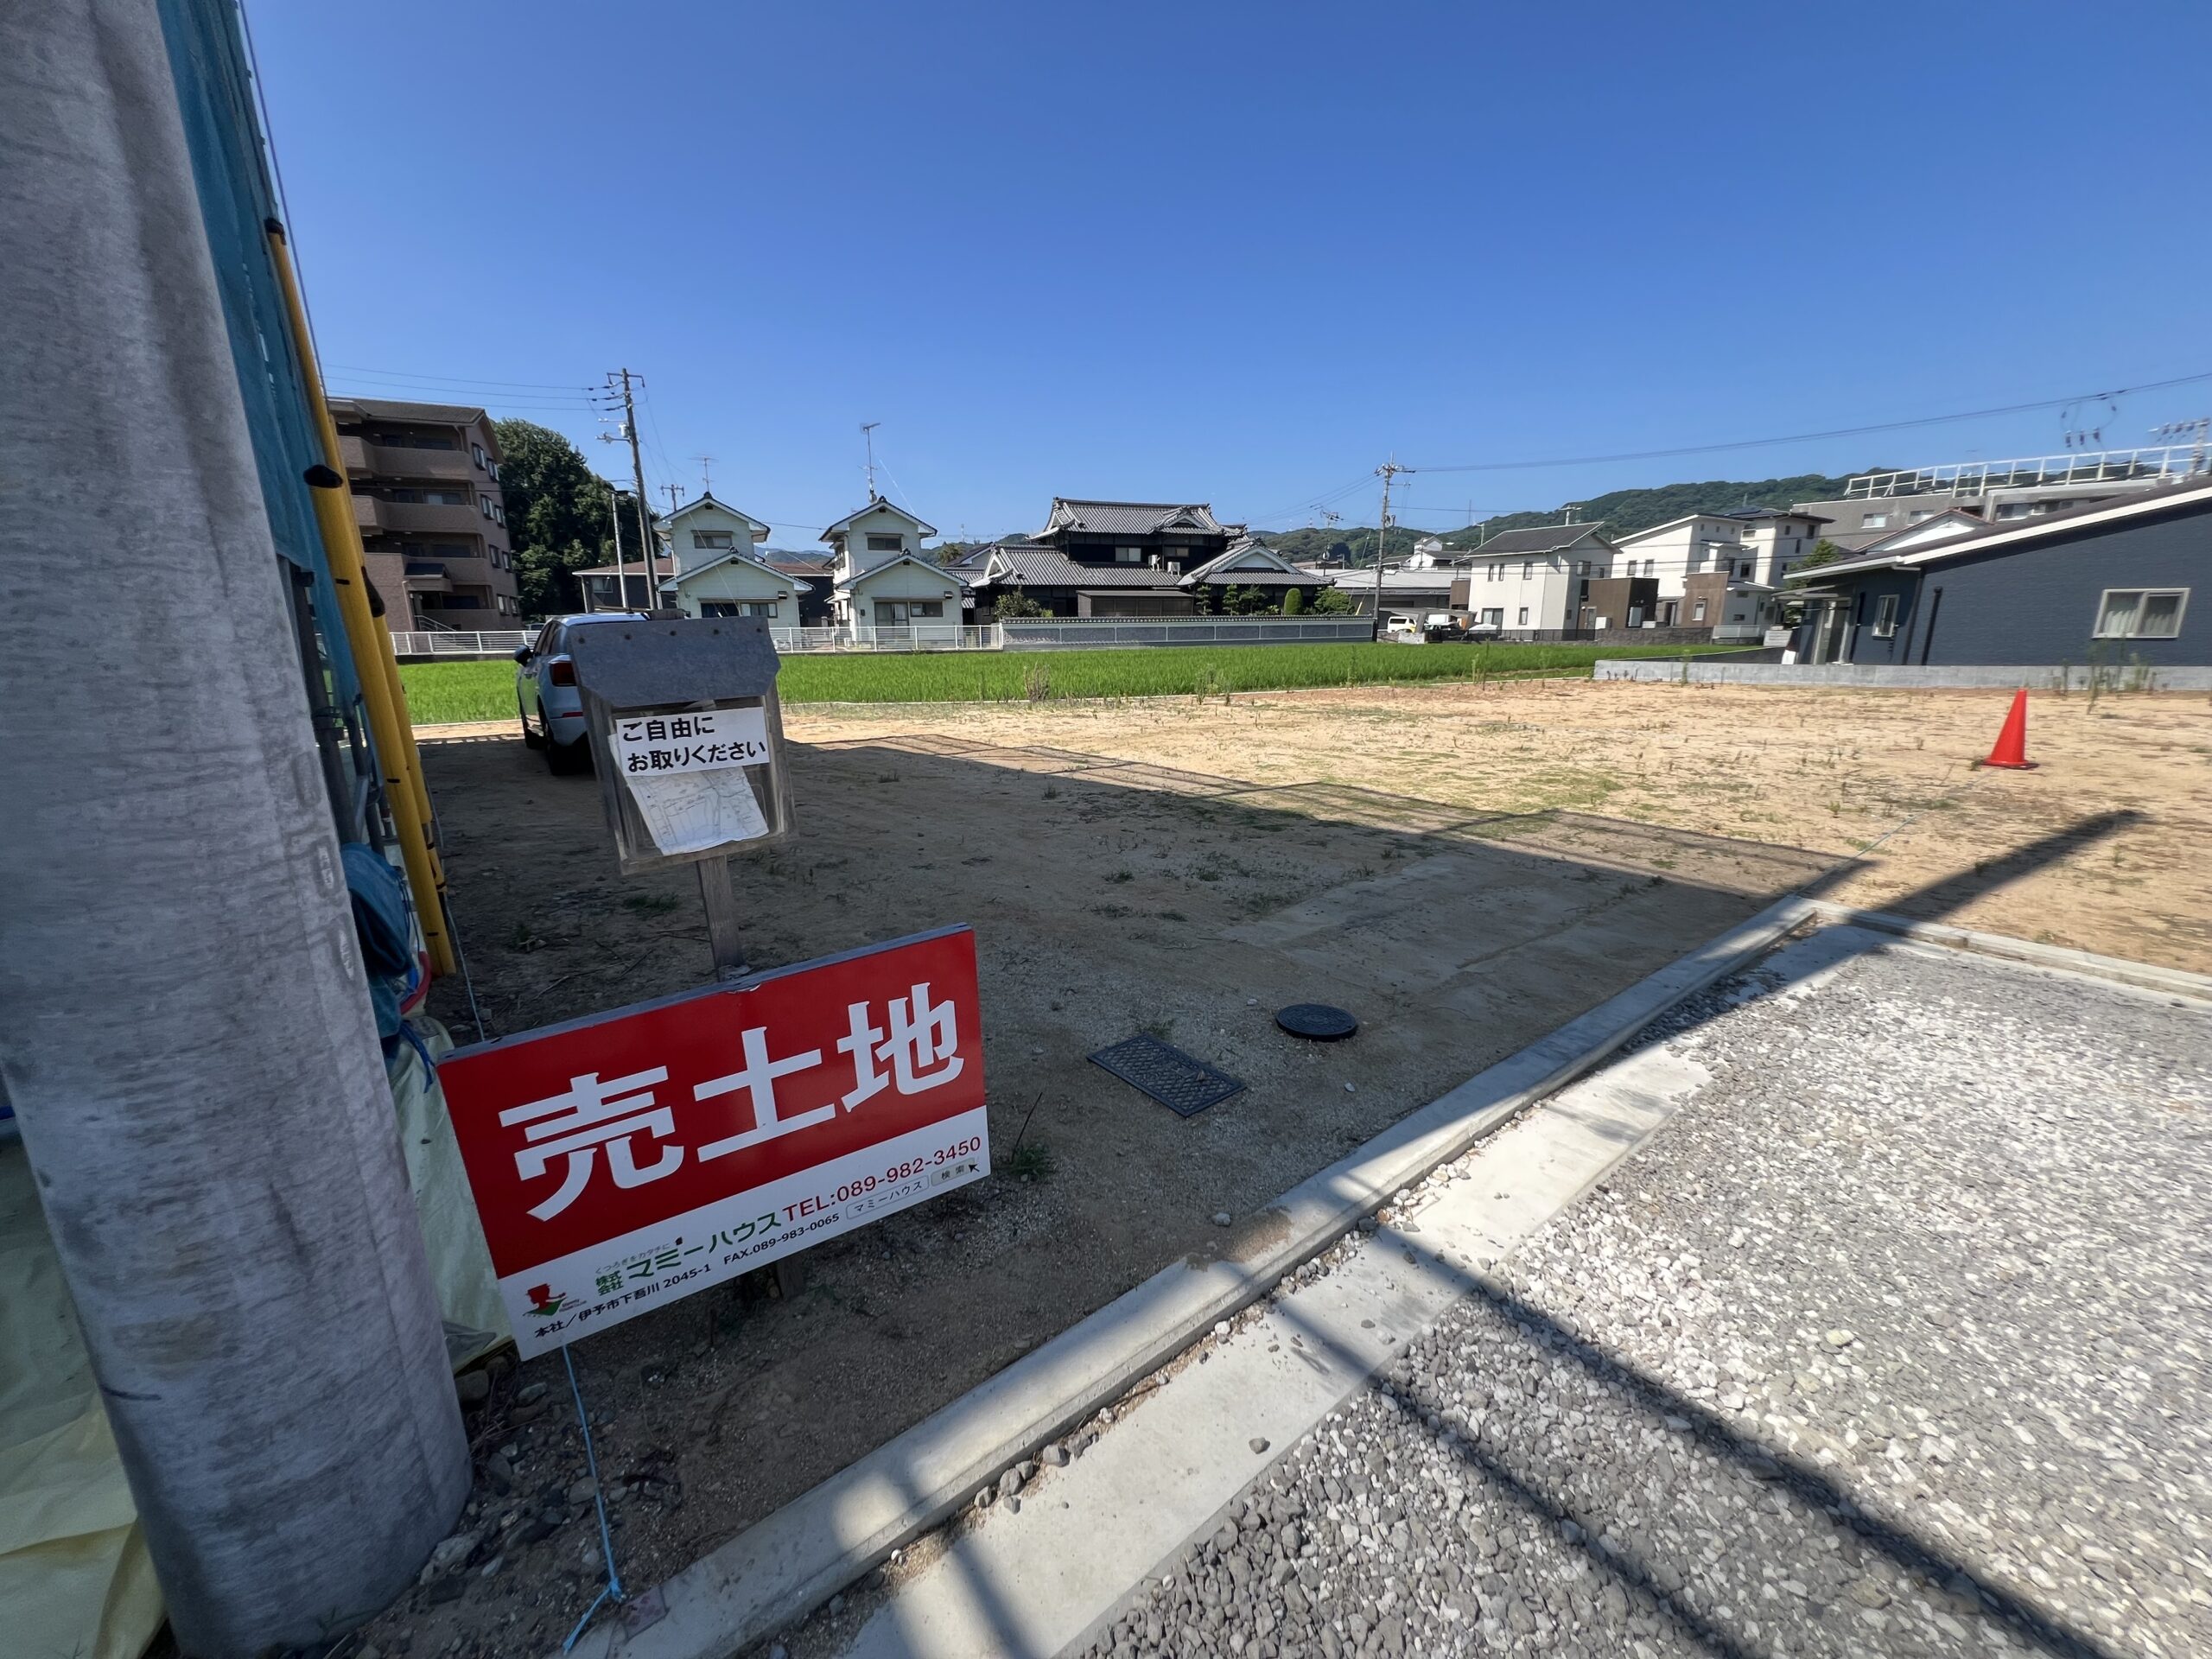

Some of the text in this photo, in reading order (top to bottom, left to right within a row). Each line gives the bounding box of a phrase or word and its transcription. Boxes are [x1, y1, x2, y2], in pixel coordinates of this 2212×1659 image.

[622, 715, 715, 741] ご自由に
[627, 741, 766, 772] お取りください
[498, 982, 965, 1222] 売土地
[782, 1136, 982, 1222] TEL:089-982-3450
[854, 1180, 923, 1212] マミーハウス
[626, 1211, 782, 1280] マミーハウス
[723, 1212, 840, 1265] FAX.089-983-0065
[663, 1263, 712, 1288] 2045-1
